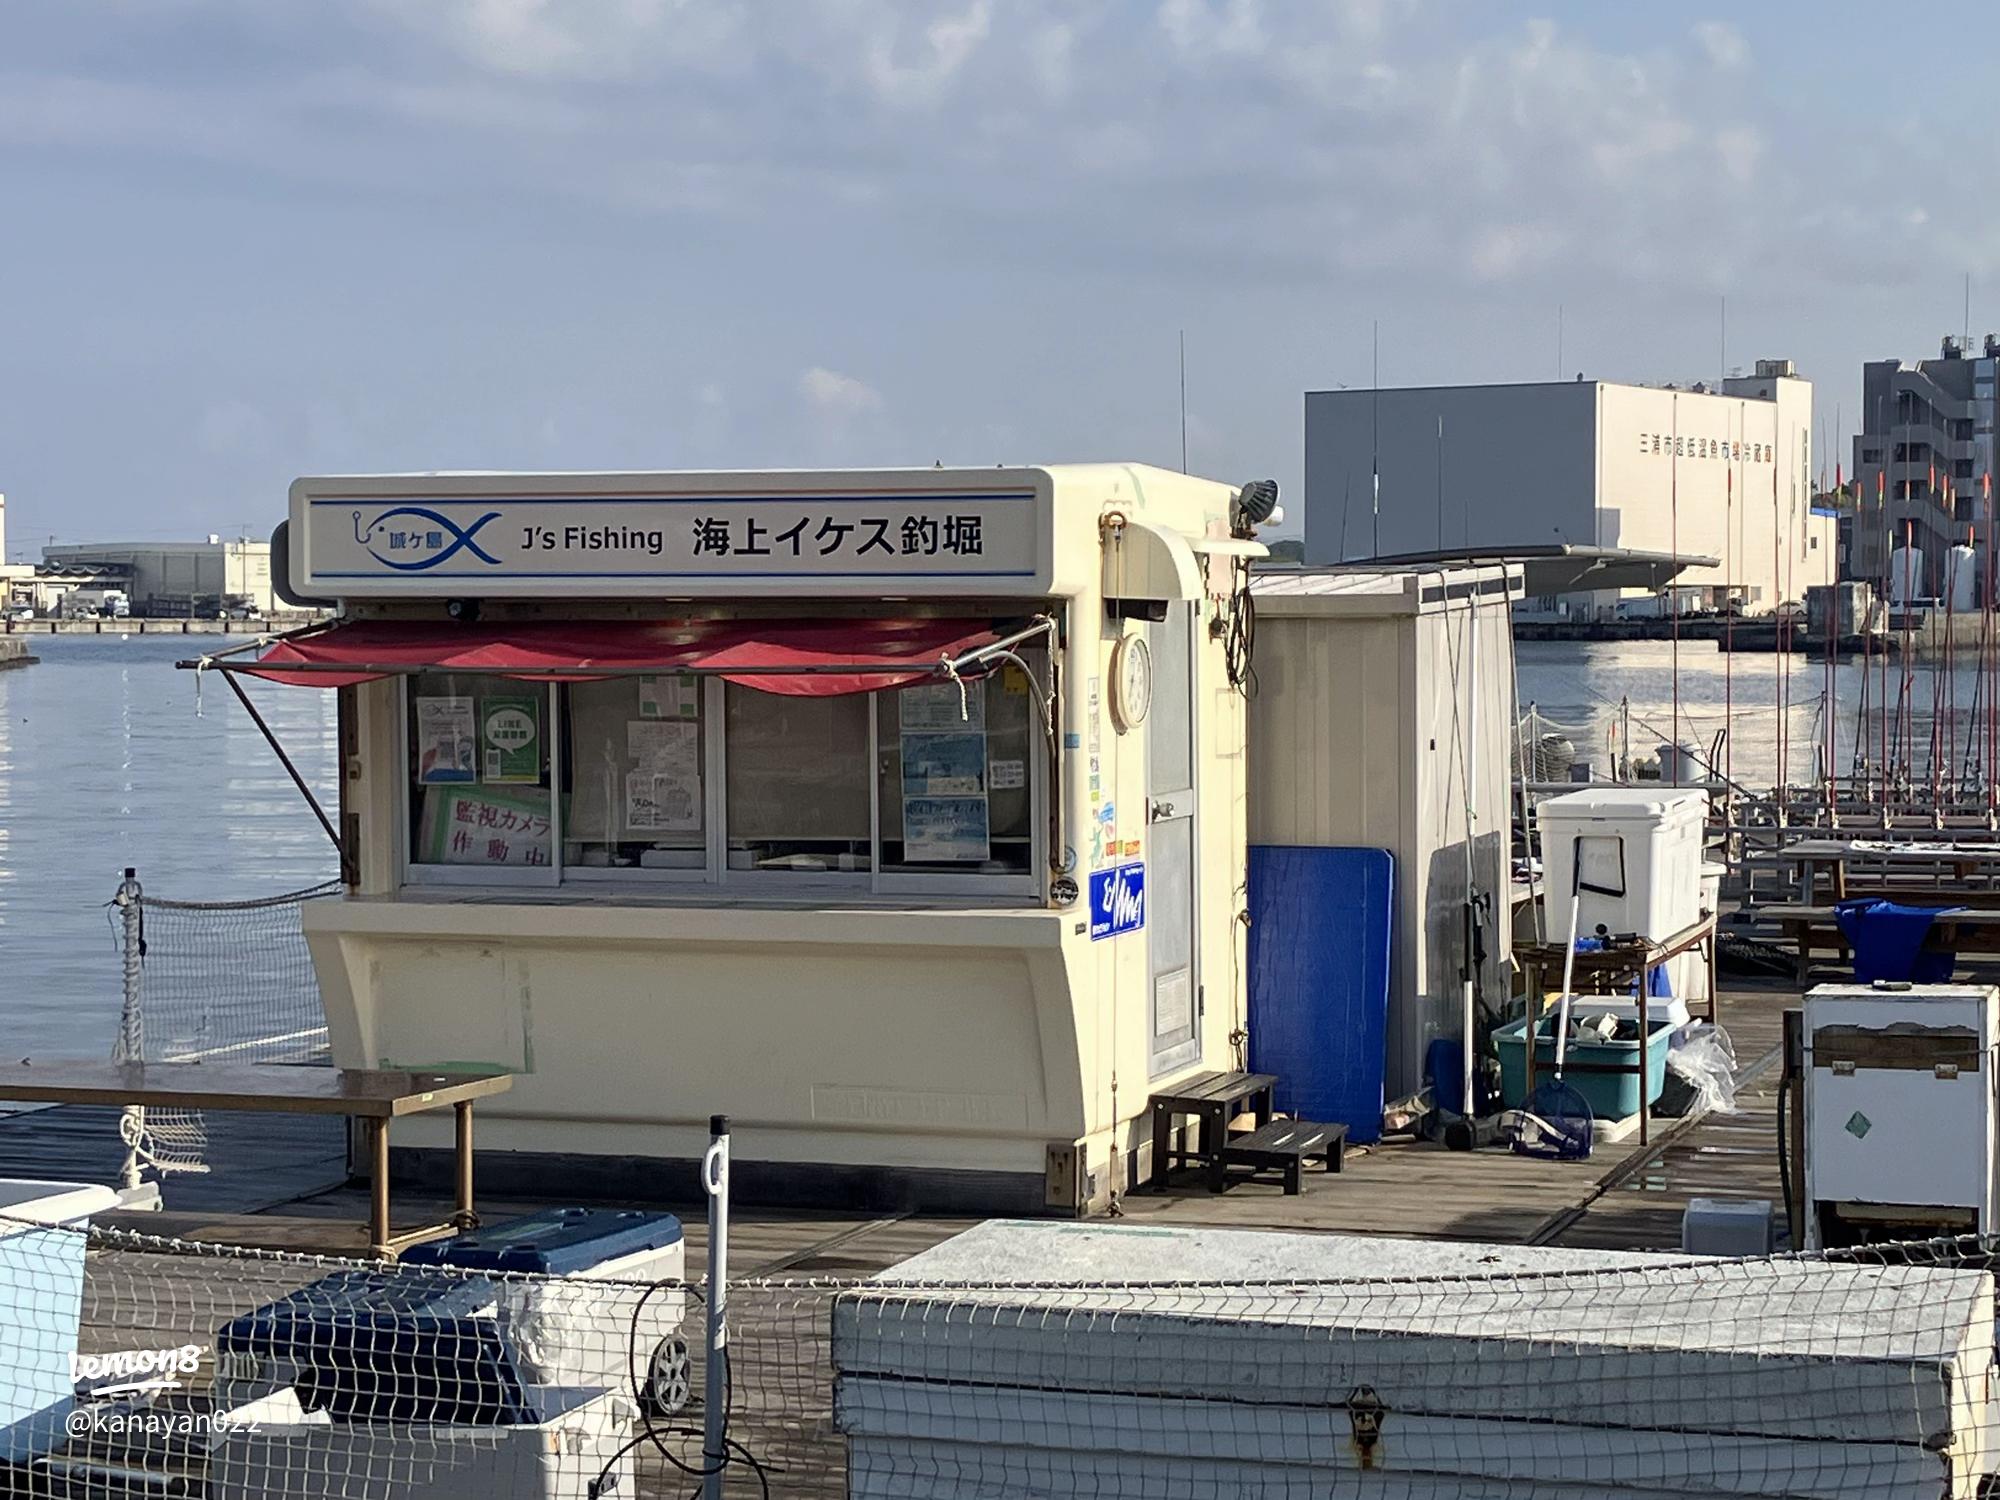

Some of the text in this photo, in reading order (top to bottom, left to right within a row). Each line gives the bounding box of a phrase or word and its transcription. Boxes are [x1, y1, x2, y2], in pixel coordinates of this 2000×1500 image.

[521, 527, 663, 554] J's Fishing
[693, 517, 983, 556] 海上イケス釣堀
[456, 800, 551, 836] 監視カメラ
